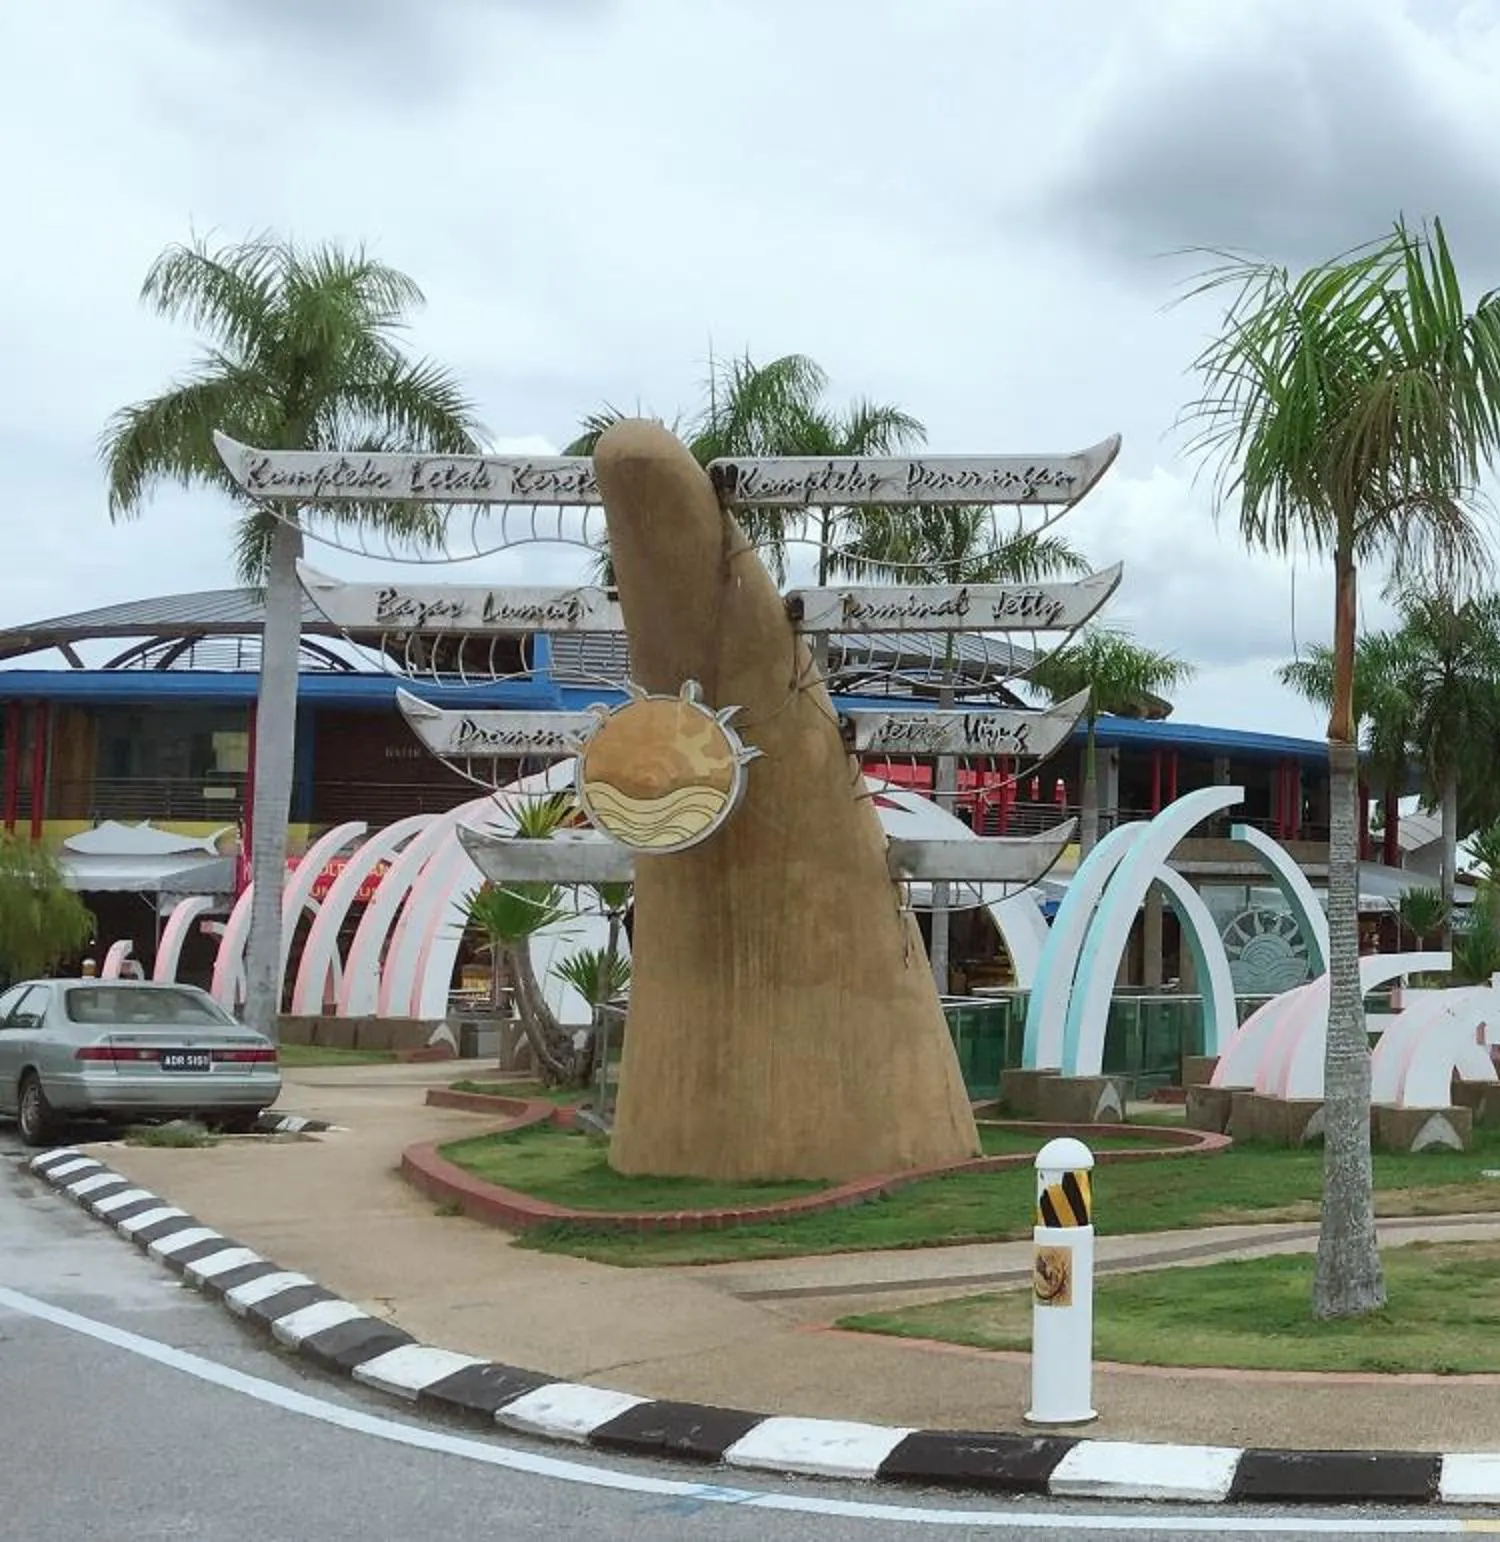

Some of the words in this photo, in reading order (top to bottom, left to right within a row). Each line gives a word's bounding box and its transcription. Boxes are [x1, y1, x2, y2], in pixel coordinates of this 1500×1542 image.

[409, 460, 493, 492] Letak
[837, 586, 971, 623] Terminal
[991, 591, 1066, 626] Jetty
